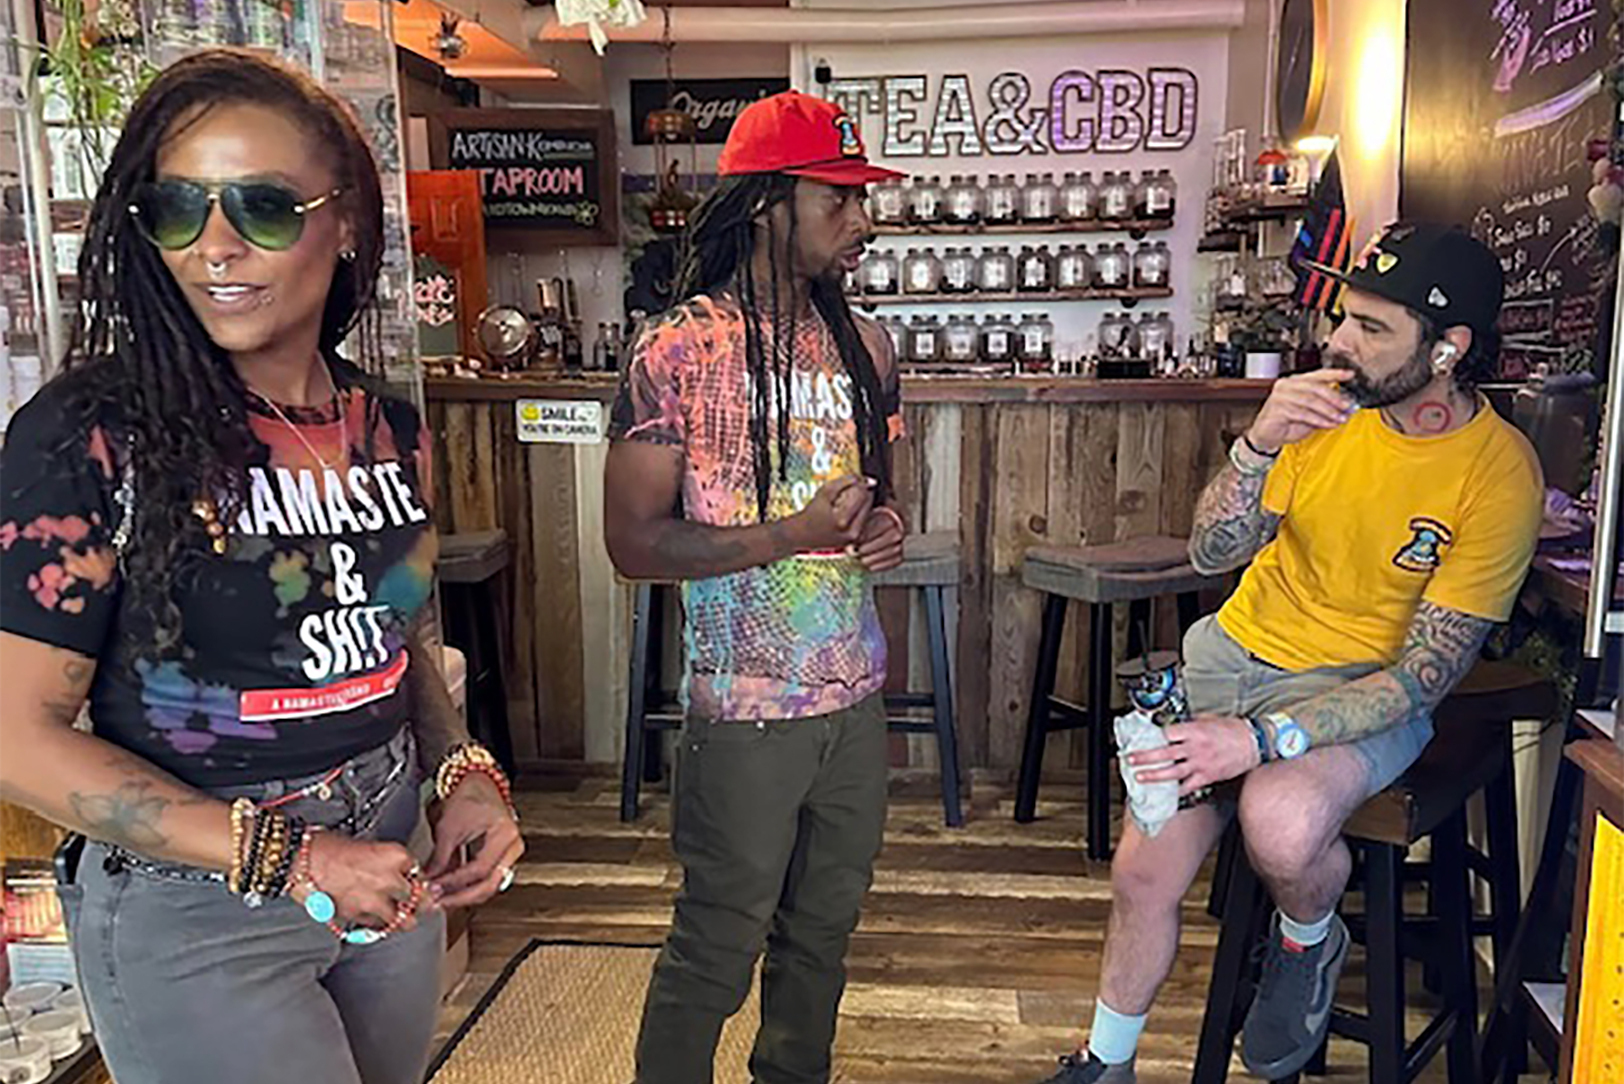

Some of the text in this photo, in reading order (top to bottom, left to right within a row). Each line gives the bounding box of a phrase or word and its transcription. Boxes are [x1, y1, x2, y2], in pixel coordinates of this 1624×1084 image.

[824, 68, 1199, 157] TEA&CBD
[477, 166, 584, 196] TAPROOM
[330, 541, 367, 604] &
[299, 604, 390, 681] SH!T
